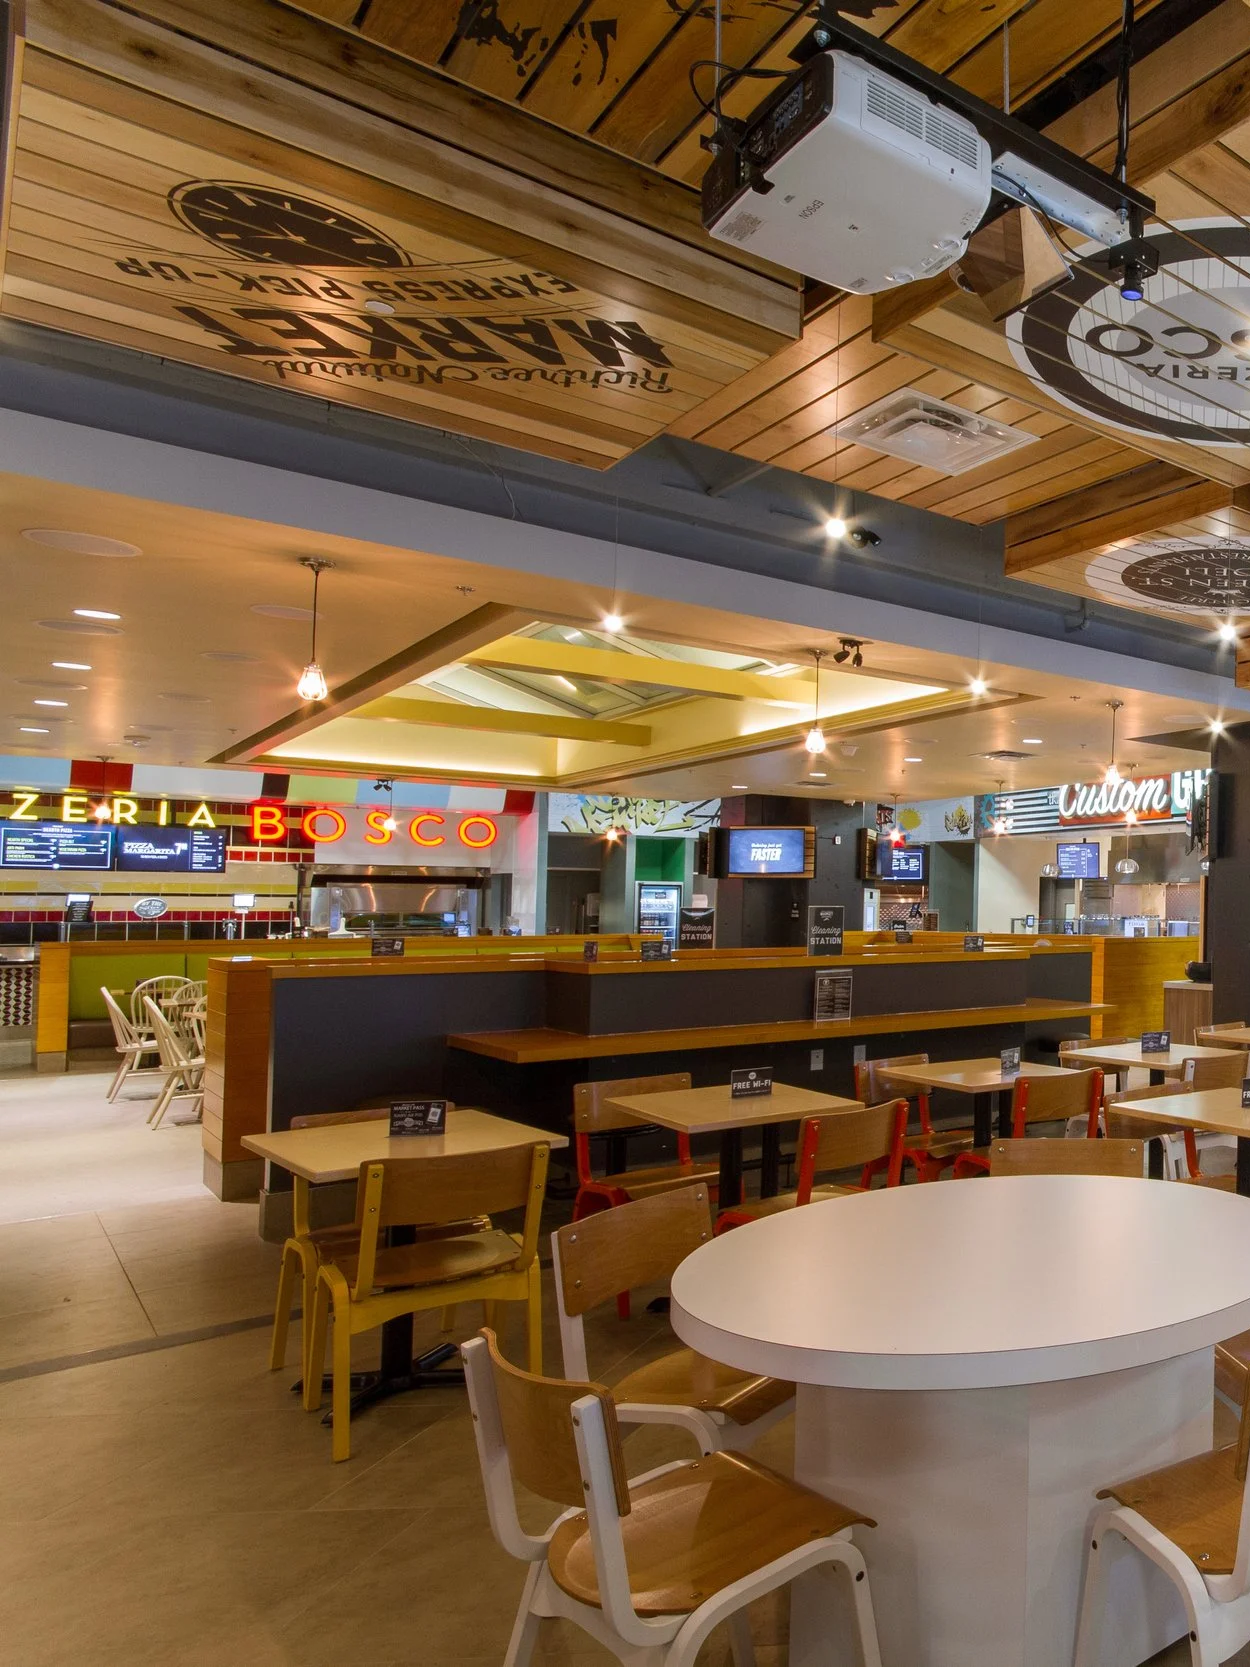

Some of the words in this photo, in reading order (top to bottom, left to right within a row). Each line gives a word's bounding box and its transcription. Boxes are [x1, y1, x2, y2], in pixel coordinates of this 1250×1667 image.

[798, 199, 825, 220] EPSON
[114, 257, 355, 300] PICK-UP
[362, 272, 580, 301] EXPRESS
[172, 306, 676, 368] MARKET
[262, 359, 480, 385] Natural
[484, 366, 674, 394] Richtree
[1059, 777, 1169, 818] Custom
[250, 805, 499, 849] BOSCO
[751, 848, 782, 861] FASTER
[681, 933, 713, 941] STATION
[682, 922, 712, 932] Cleaning
[811, 925, 842, 935] Cleaning
[810, 936, 842, 946] STATION
[733, 1081, 751, 1090] FREE
[752, 1079, 771, 1088] WI-FI
